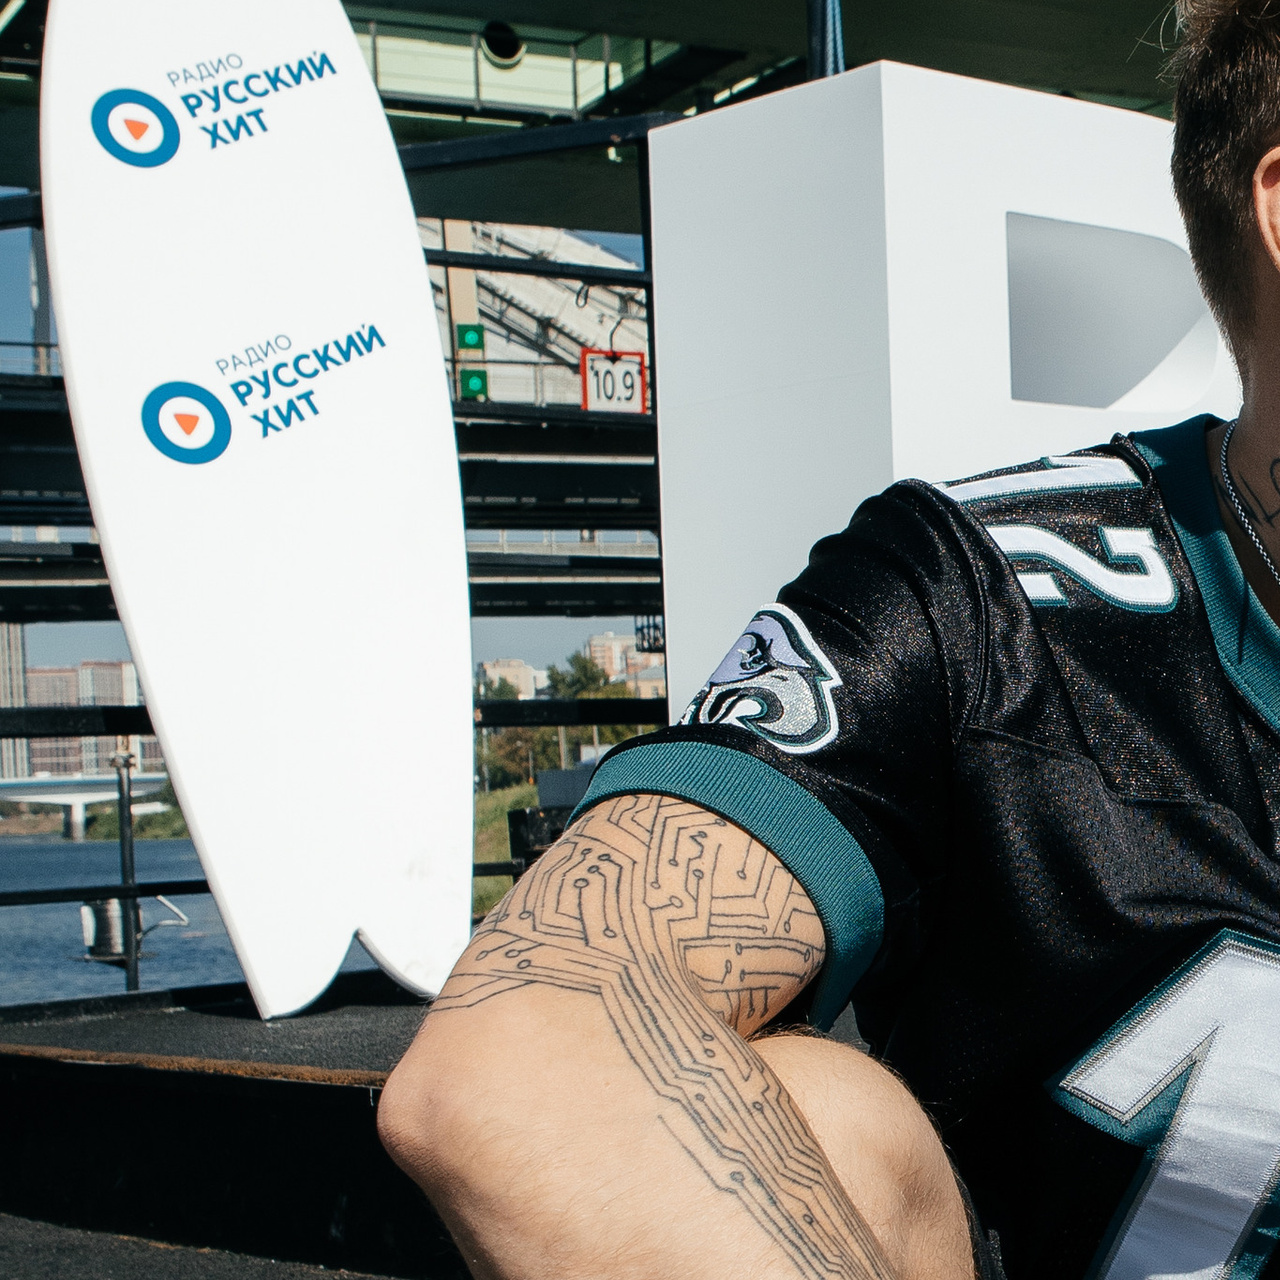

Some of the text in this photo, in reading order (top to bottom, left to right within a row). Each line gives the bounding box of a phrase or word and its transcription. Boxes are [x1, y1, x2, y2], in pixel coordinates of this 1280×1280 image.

[167, 53, 244, 88] РАДИО
[180, 50, 337, 119] РУССКИЙ
[199, 108, 269, 150] ХИТ
[215, 334, 293, 376] РАДИО
[229, 323, 387, 407] РУССКИЙ
[593, 369, 634, 401] 10.9
[250, 389, 320, 439] ХИТ
